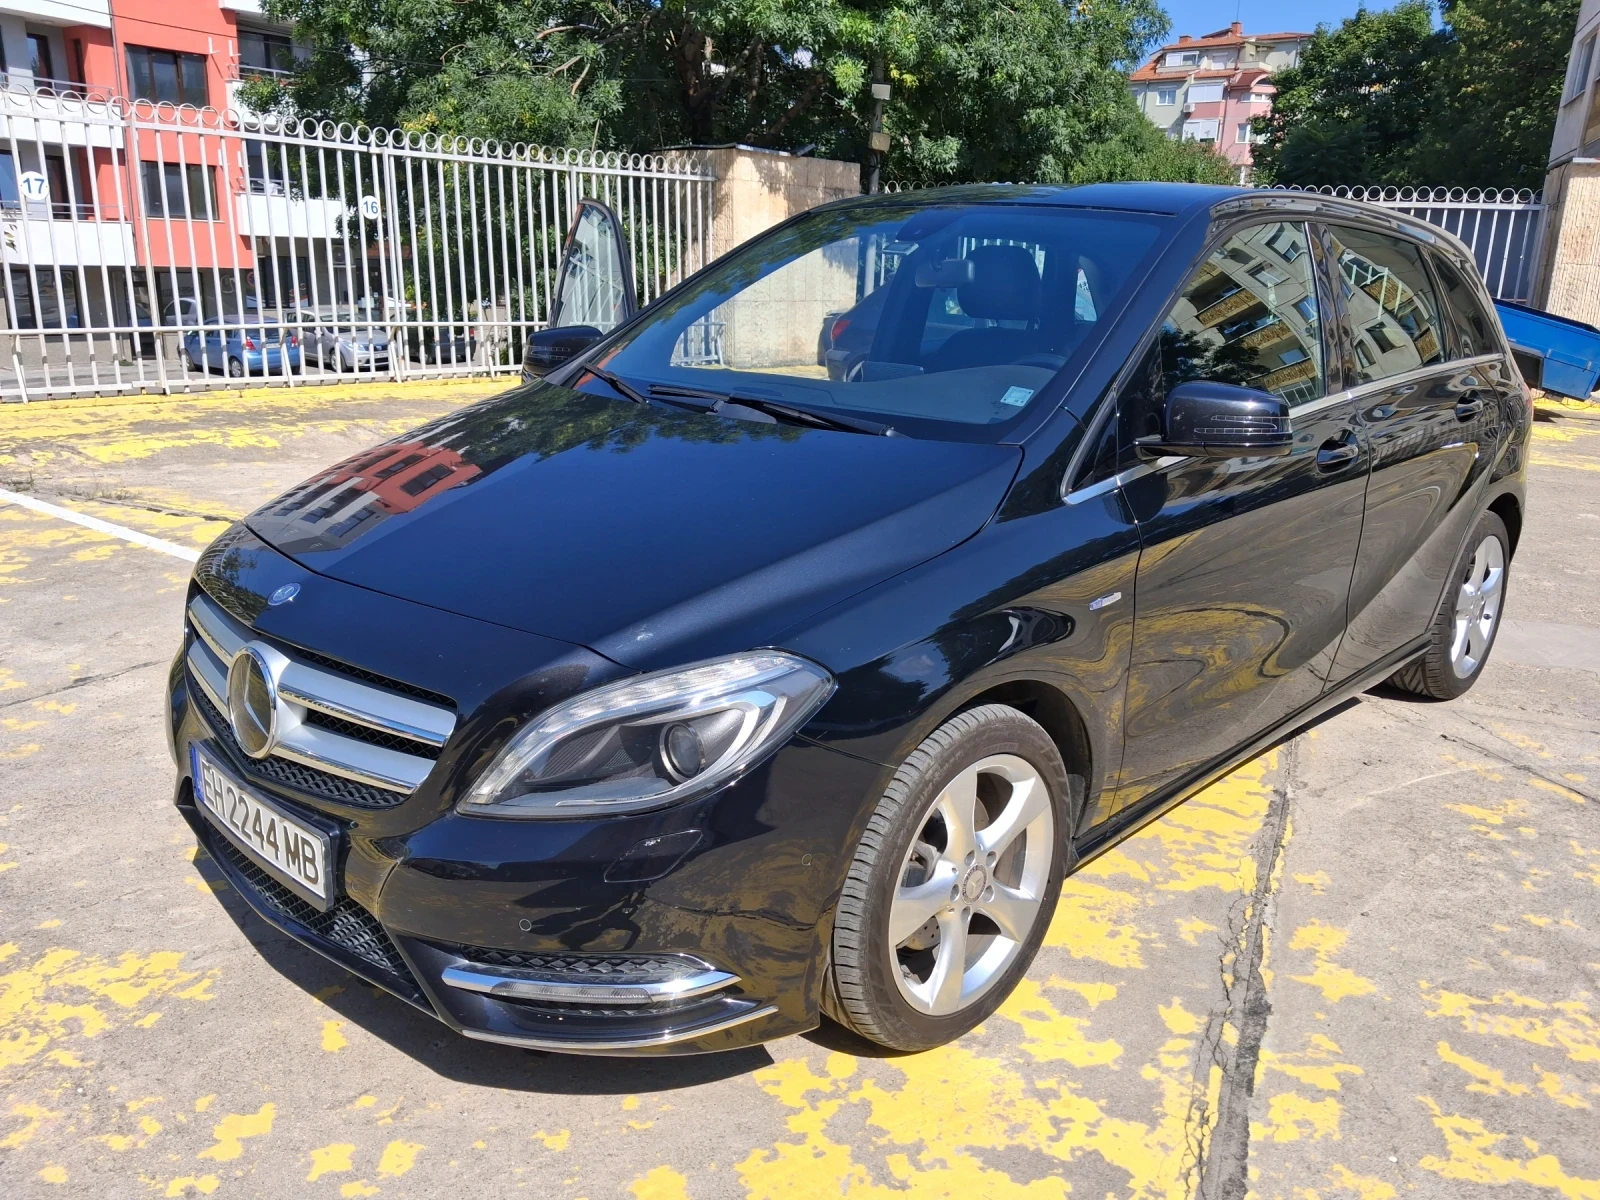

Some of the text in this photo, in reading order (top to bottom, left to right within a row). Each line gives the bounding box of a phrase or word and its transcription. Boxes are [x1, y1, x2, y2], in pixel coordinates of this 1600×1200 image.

[23, 177, 45, 194] 17
[363, 200, 379, 215] 16
[202, 760, 319, 885] EH 2244 MB
